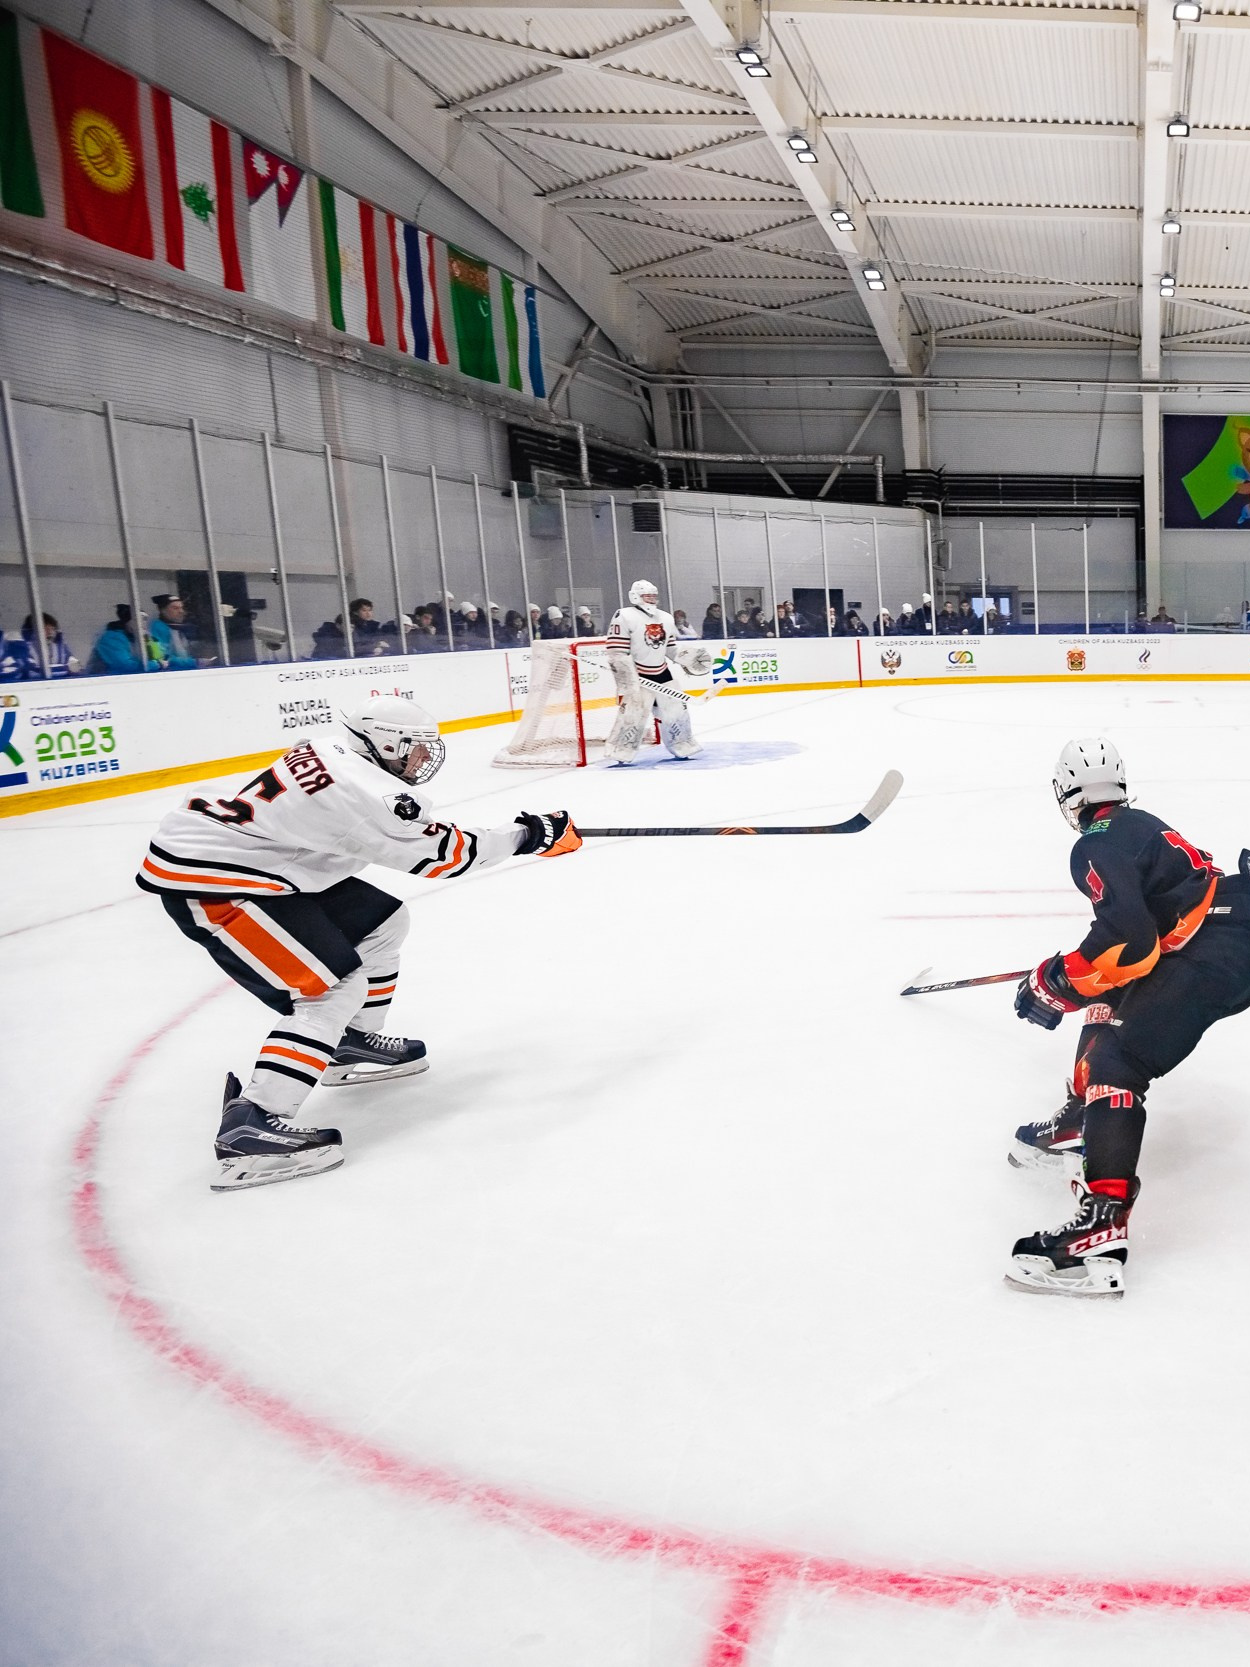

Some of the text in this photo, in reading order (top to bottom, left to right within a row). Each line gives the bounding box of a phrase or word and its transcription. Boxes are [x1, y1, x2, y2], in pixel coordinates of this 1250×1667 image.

[742, 660, 778, 673] 2023
[278, 670, 322, 682] CHILDREN
[325, 669, 336, 679] OF
[340, 668, 356, 677] ASIA
[278, 698, 331, 714] NATURAL
[282, 712, 332, 729] ADVANCE
[35, 726, 116, 762] 2023
[40, 759, 120, 781] KUZBASS
